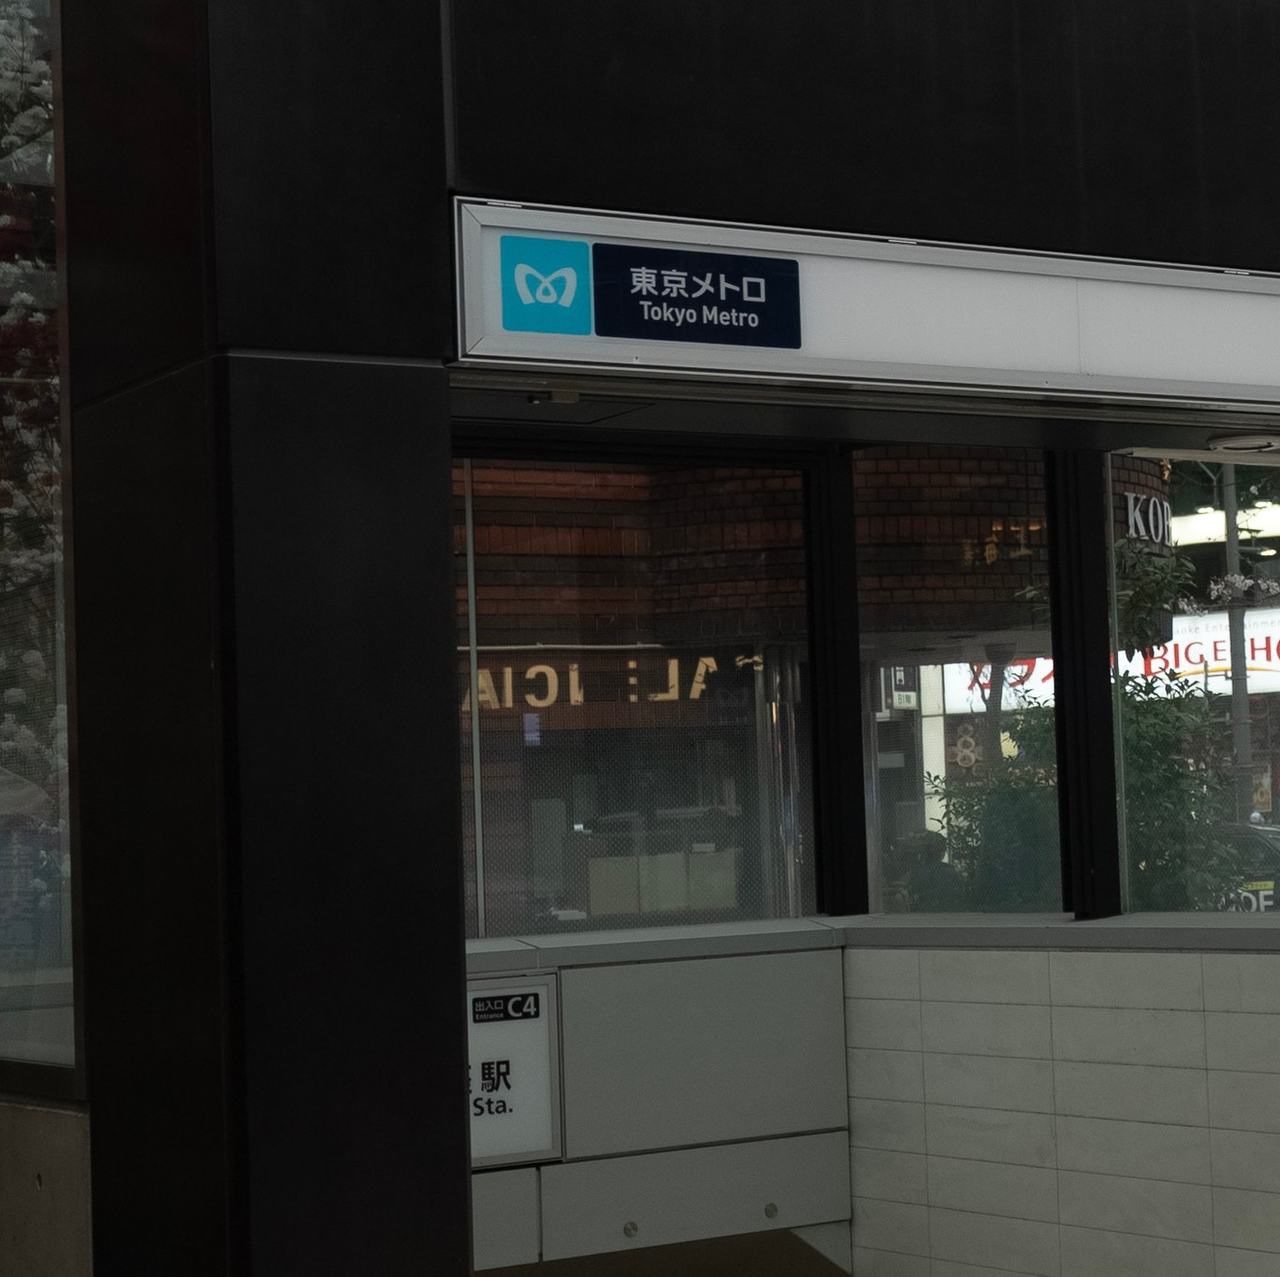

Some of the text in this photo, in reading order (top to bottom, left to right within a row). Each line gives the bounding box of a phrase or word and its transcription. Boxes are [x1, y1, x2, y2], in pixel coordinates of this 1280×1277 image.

[630, 266, 766, 303] 東京メトロ
[639, 300, 759, 328] Tokyo Metro
[1143, 641, 1205, 677] BIG
[475, 995, 537, 1018] 出入口 C4
[475, 1013, 504, 1021] Entrance
[469, 1060, 511, 1093] 駅
[473, 1097, 513, 1117] Sta.
